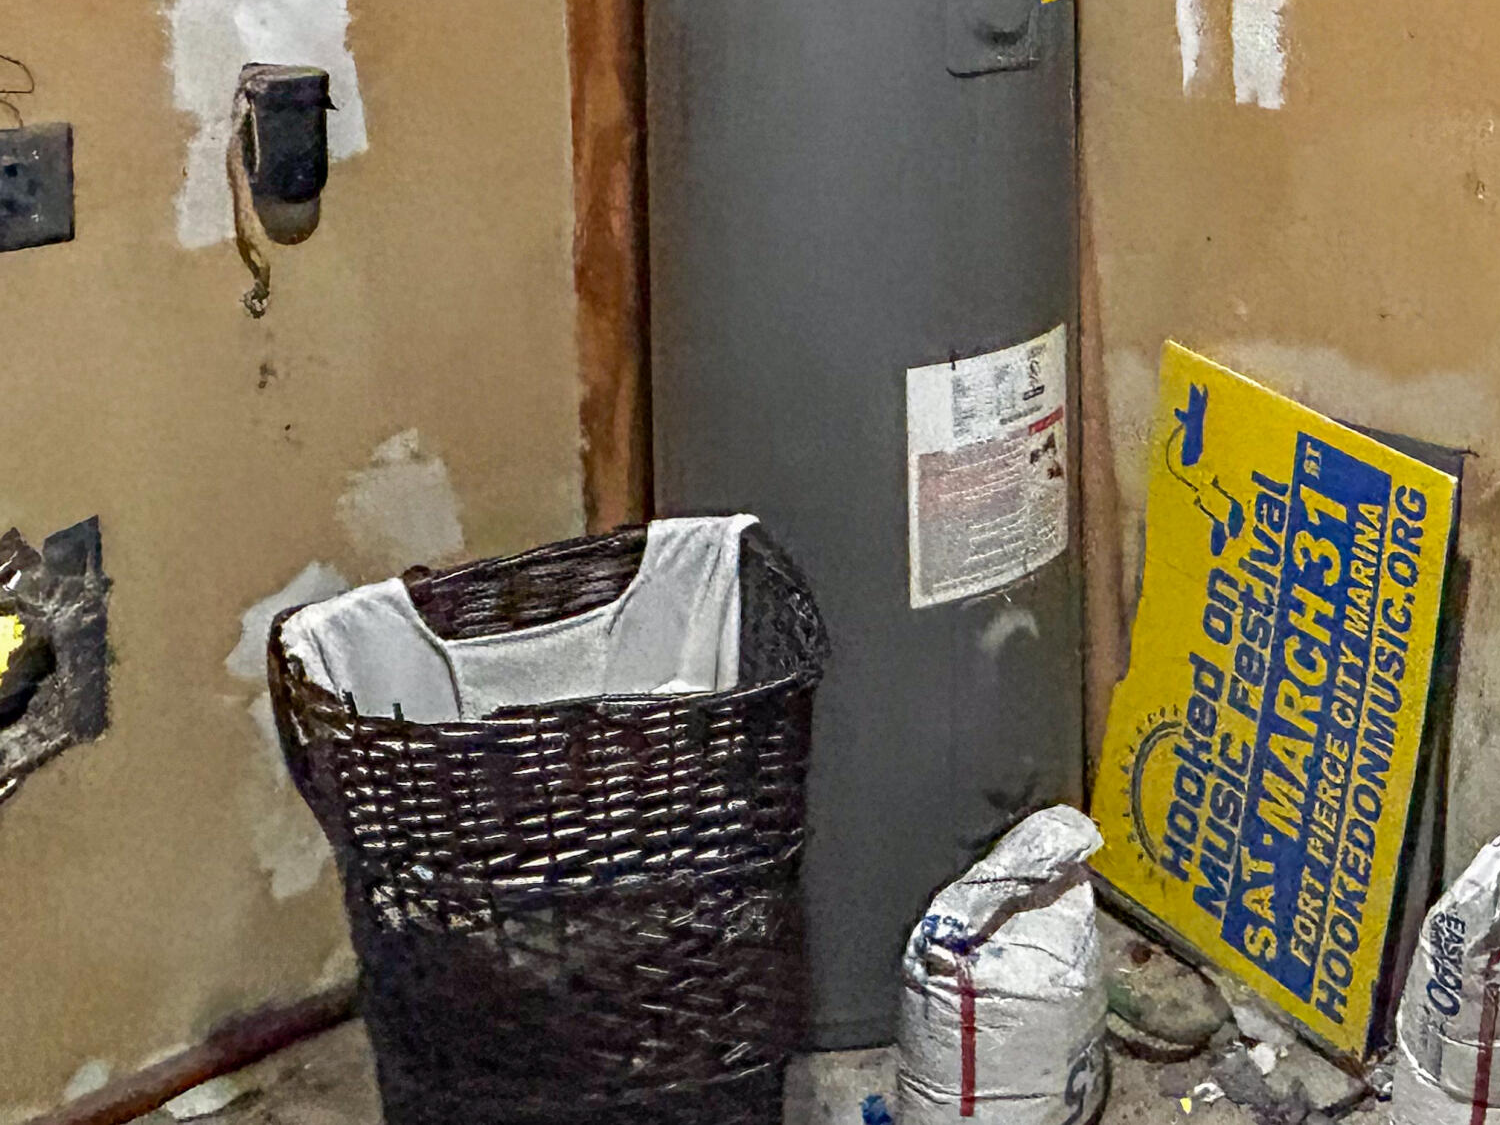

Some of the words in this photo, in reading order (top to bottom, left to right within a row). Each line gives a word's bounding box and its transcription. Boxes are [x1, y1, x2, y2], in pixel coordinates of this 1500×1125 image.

[1202, 568, 1239, 645] on
[1343, 503, 1384, 640] MARINA
[1257, 584, 1335, 841] MARCH
[1331, 642, 1364, 729] CITY
[1307, 732, 1350, 867] PIERCE
[1315, 484, 1428, 1024] HOOKEDONMUSIC.ORG
[1290, 867, 1328, 966] FORT
